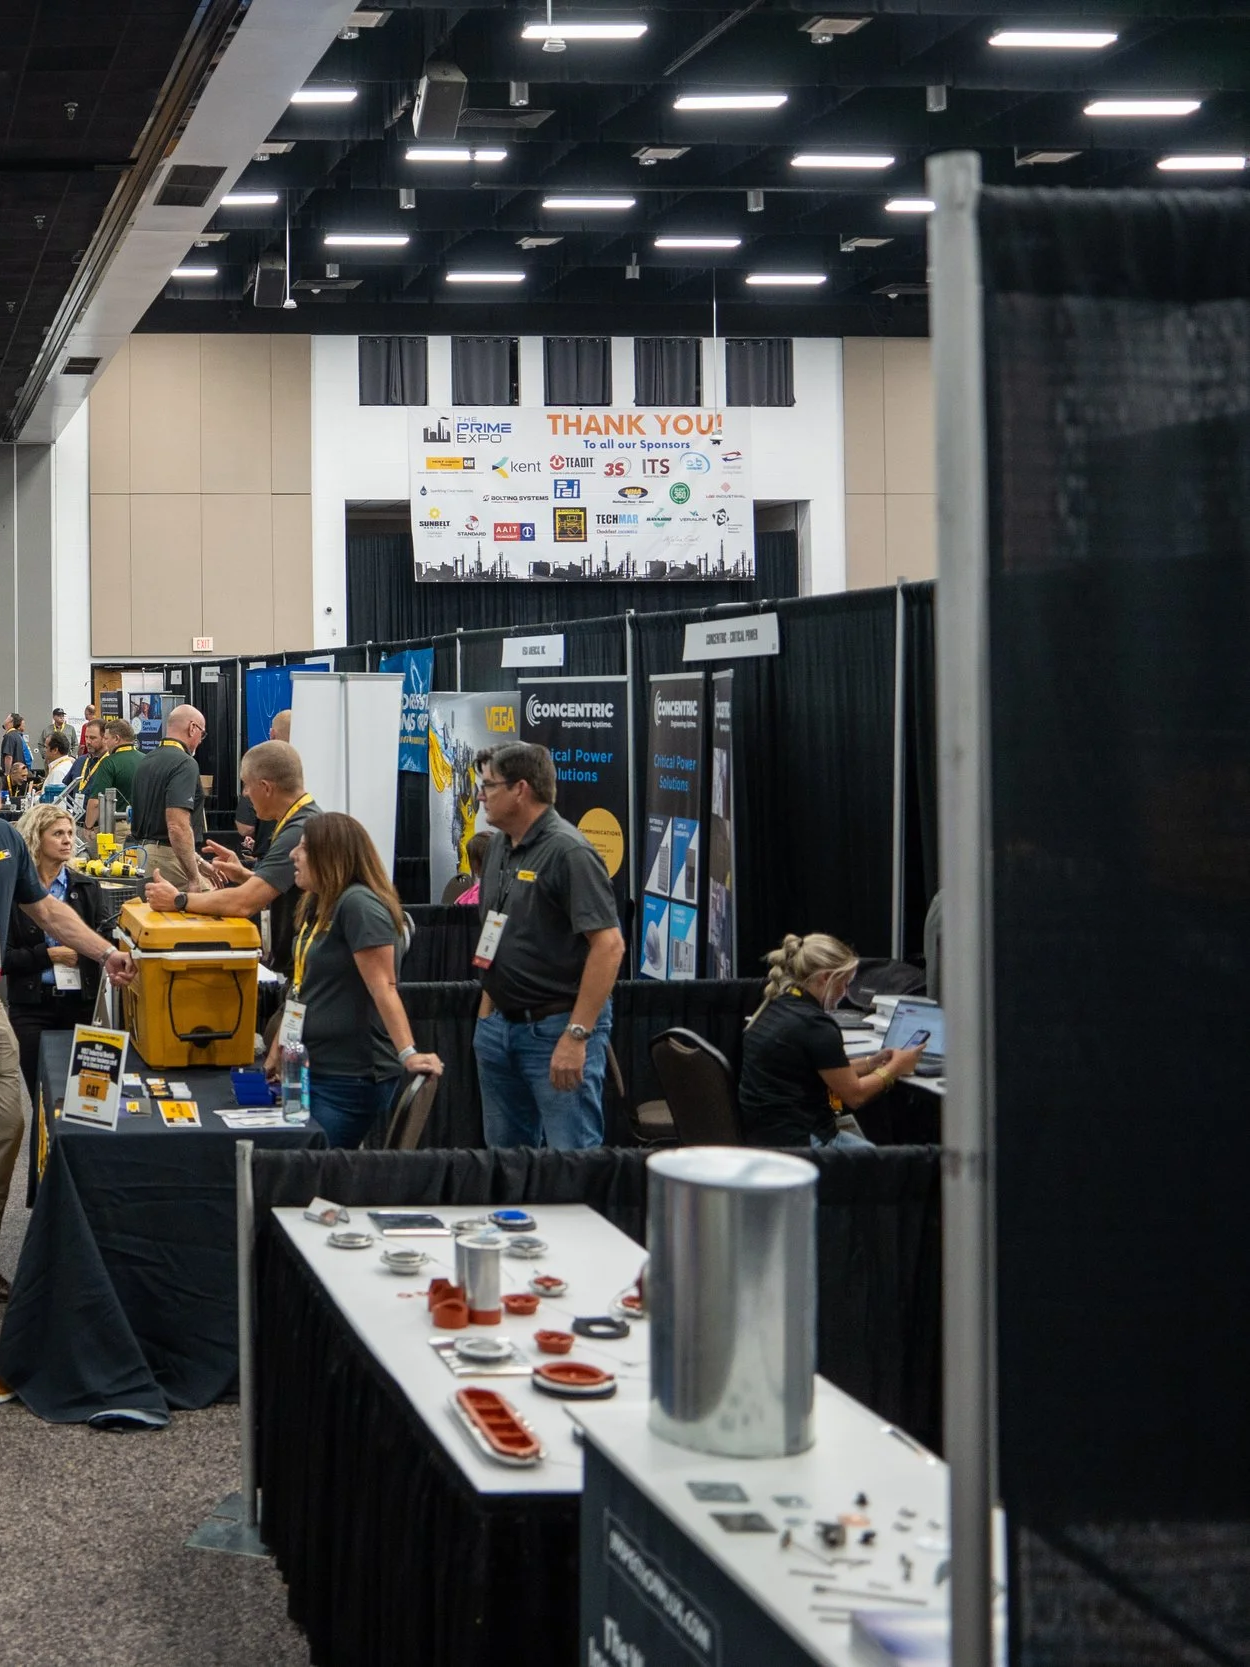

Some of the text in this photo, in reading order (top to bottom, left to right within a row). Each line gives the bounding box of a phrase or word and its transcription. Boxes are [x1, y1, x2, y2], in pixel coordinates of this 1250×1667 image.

[457, 423, 512, 433] PRIME
[547, 414, 723, 435] THANK YOU!
[457, 434, 502, 444] EXPO
[583, 439, 690, 452] To all our Sponsors
[510, 460, 541, 472] kent
[566, 457, 594, 468] TEADIT
[604, 462, 625, 476] 3S
[642, 459, 670, 475] ITS
[673, 491, 686, 499] 360
[596, 514, 639, 524] TECHMAR
[196, 639, 210, 649] EXIT
[533, 702, 614, 718] CONCENTRIC
[657, 700, 697, 716] CONCENTRIC
[485, 706, 516, 732] VEGA
[561, 720, 613, 728] Engineering Uptime.
[576, 749, 613, 763] Power
[653, 753, 697, 772] Critical Power
[658, 775, 690, 792] Solutions
[85, 1084, 99, 1098] CAT
